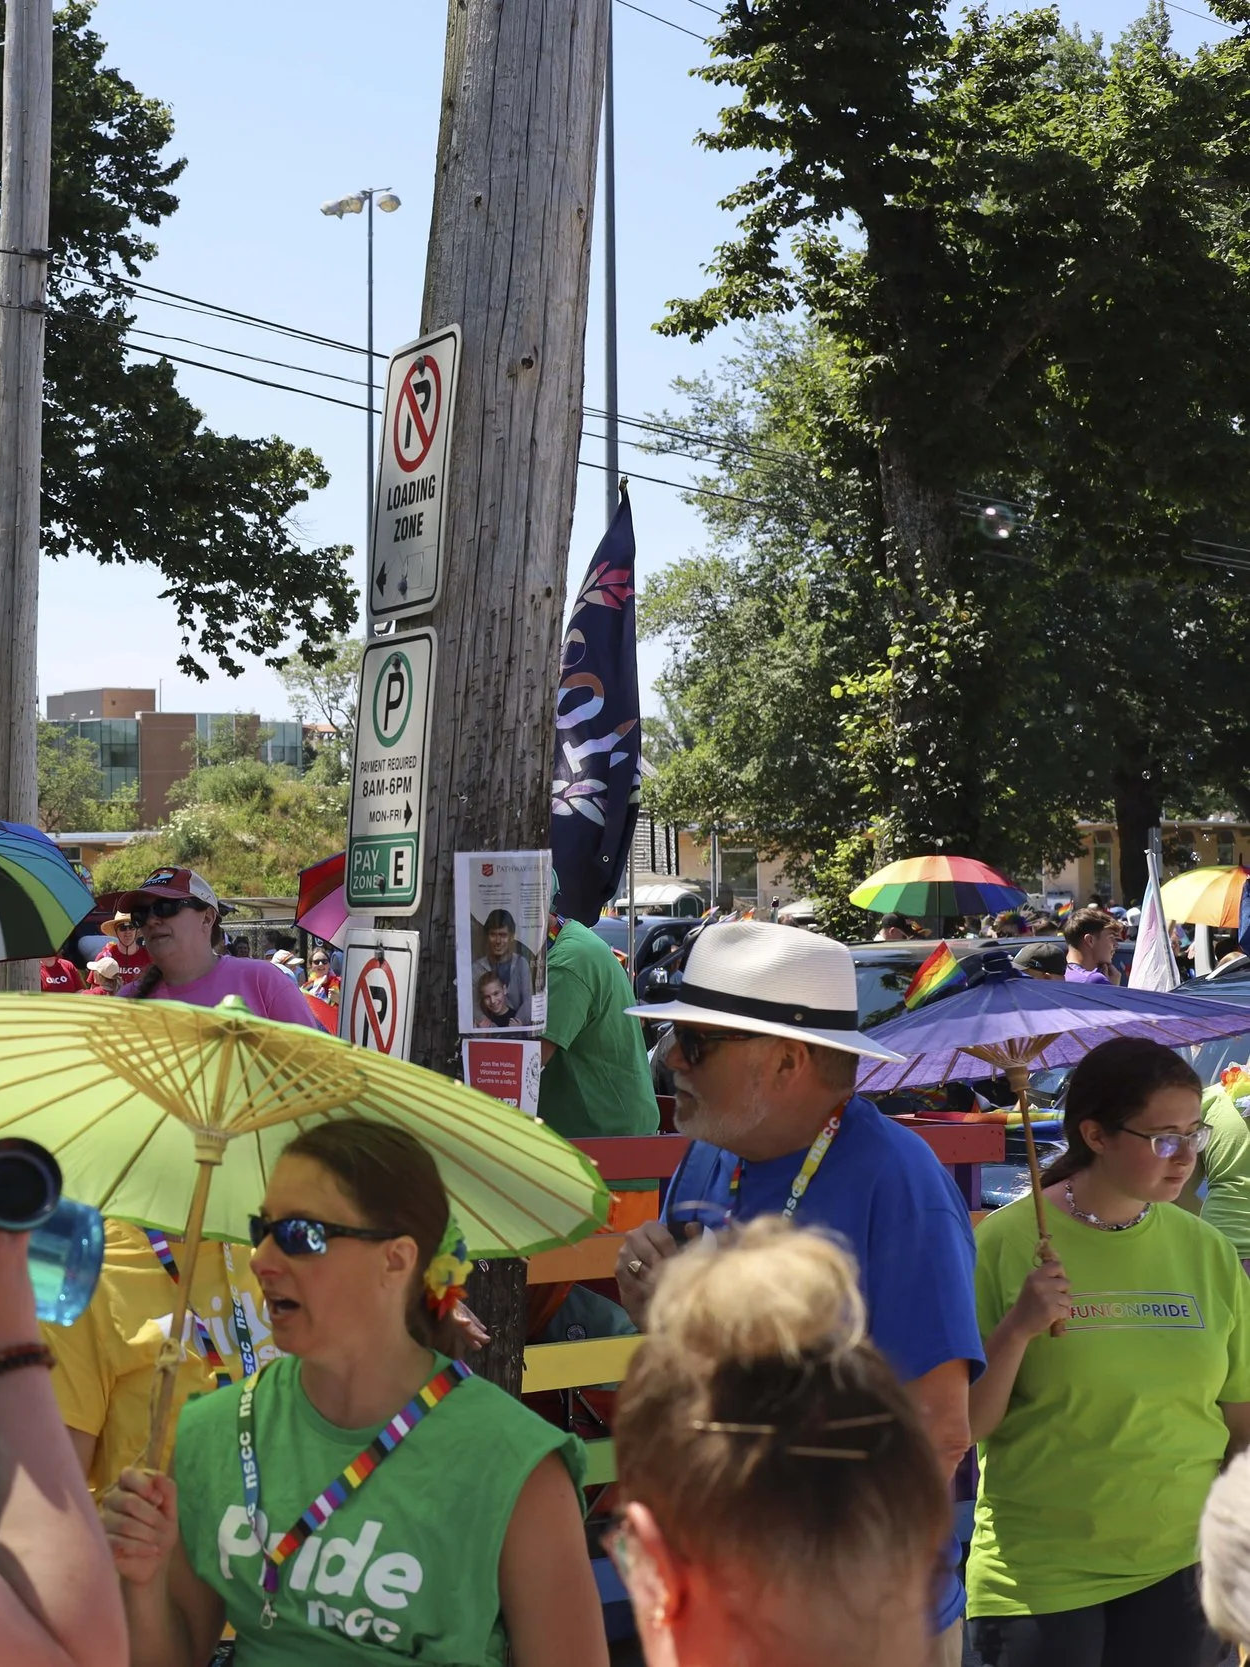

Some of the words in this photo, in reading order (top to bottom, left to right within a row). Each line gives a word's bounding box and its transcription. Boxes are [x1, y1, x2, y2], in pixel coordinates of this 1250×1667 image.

[387, 474, 436, 511] LOADING
[393, 511, 424, 543] ZONE
[383, 671, 405, 731] P
[360, 758, 386, 774] PAYMENT
[387, 755, 417, 771] REQUIRED
[362, 775, 412, 798] 8AM-6PM
[368, 808, 402, 823] MON-FRI
[353, 849, 380, 872] PAY
[393, 850, 404, 887] E
[353, 874, 379, 889] ZONE
[810, 1116, 841, 1163] nscc
[230, 1285, 247, 1330] nscc
[240, 1341, 255, 1377] scc
[239, 1430, 259, 1489] nscc
